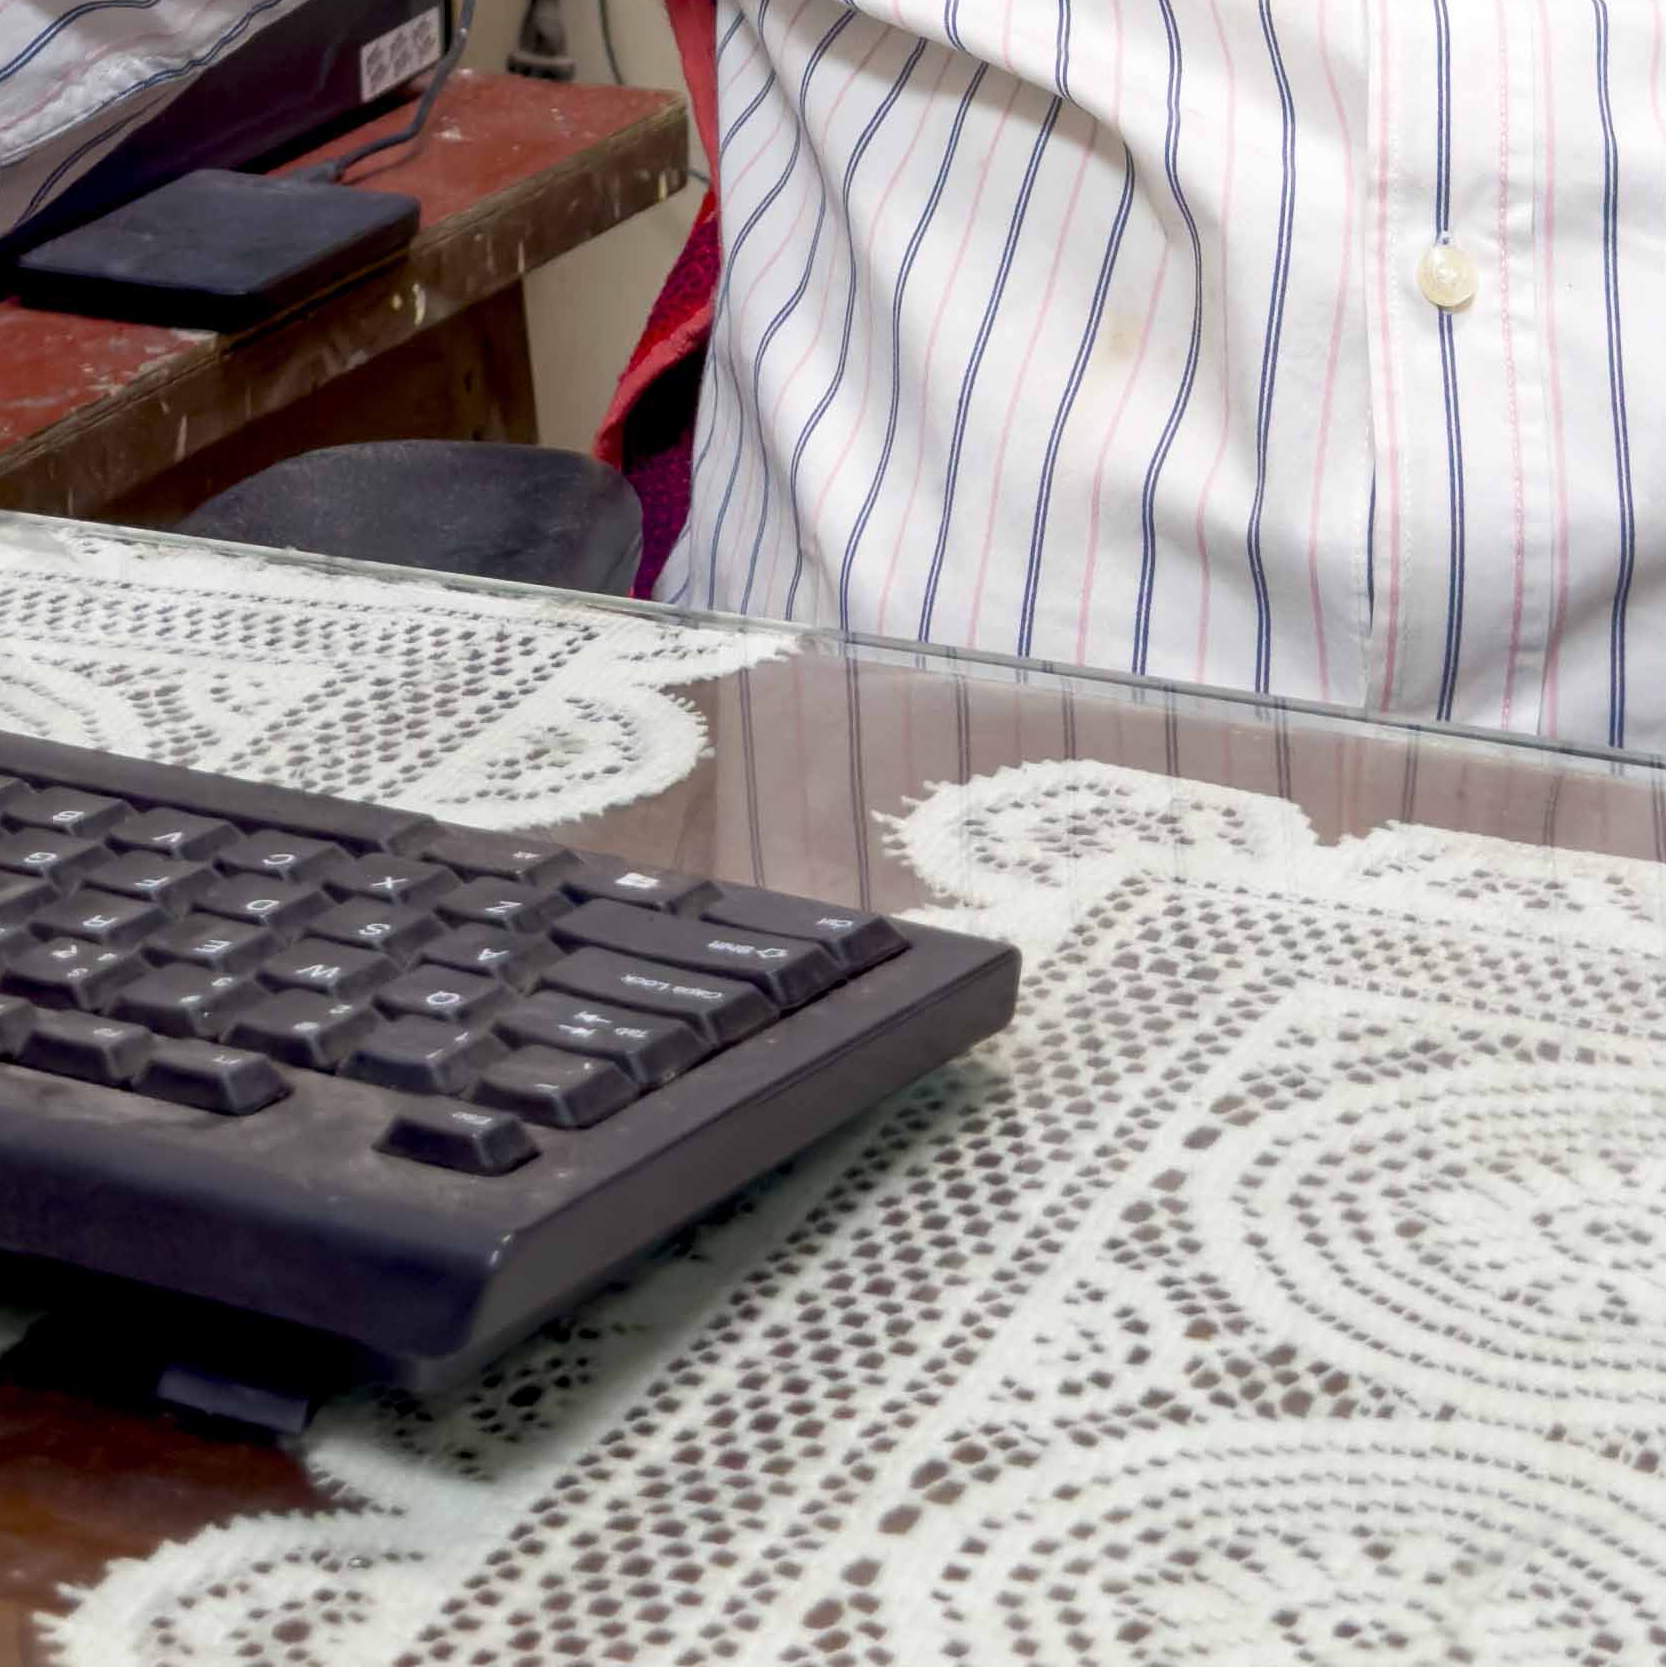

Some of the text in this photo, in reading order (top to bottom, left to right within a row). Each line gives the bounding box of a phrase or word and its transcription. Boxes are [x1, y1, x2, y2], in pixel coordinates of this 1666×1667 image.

[619, 974, 724, 1001] Caps Lock
[425, 990, 461, 1006] Q
[613, 1026, 649, 1039] Tab
